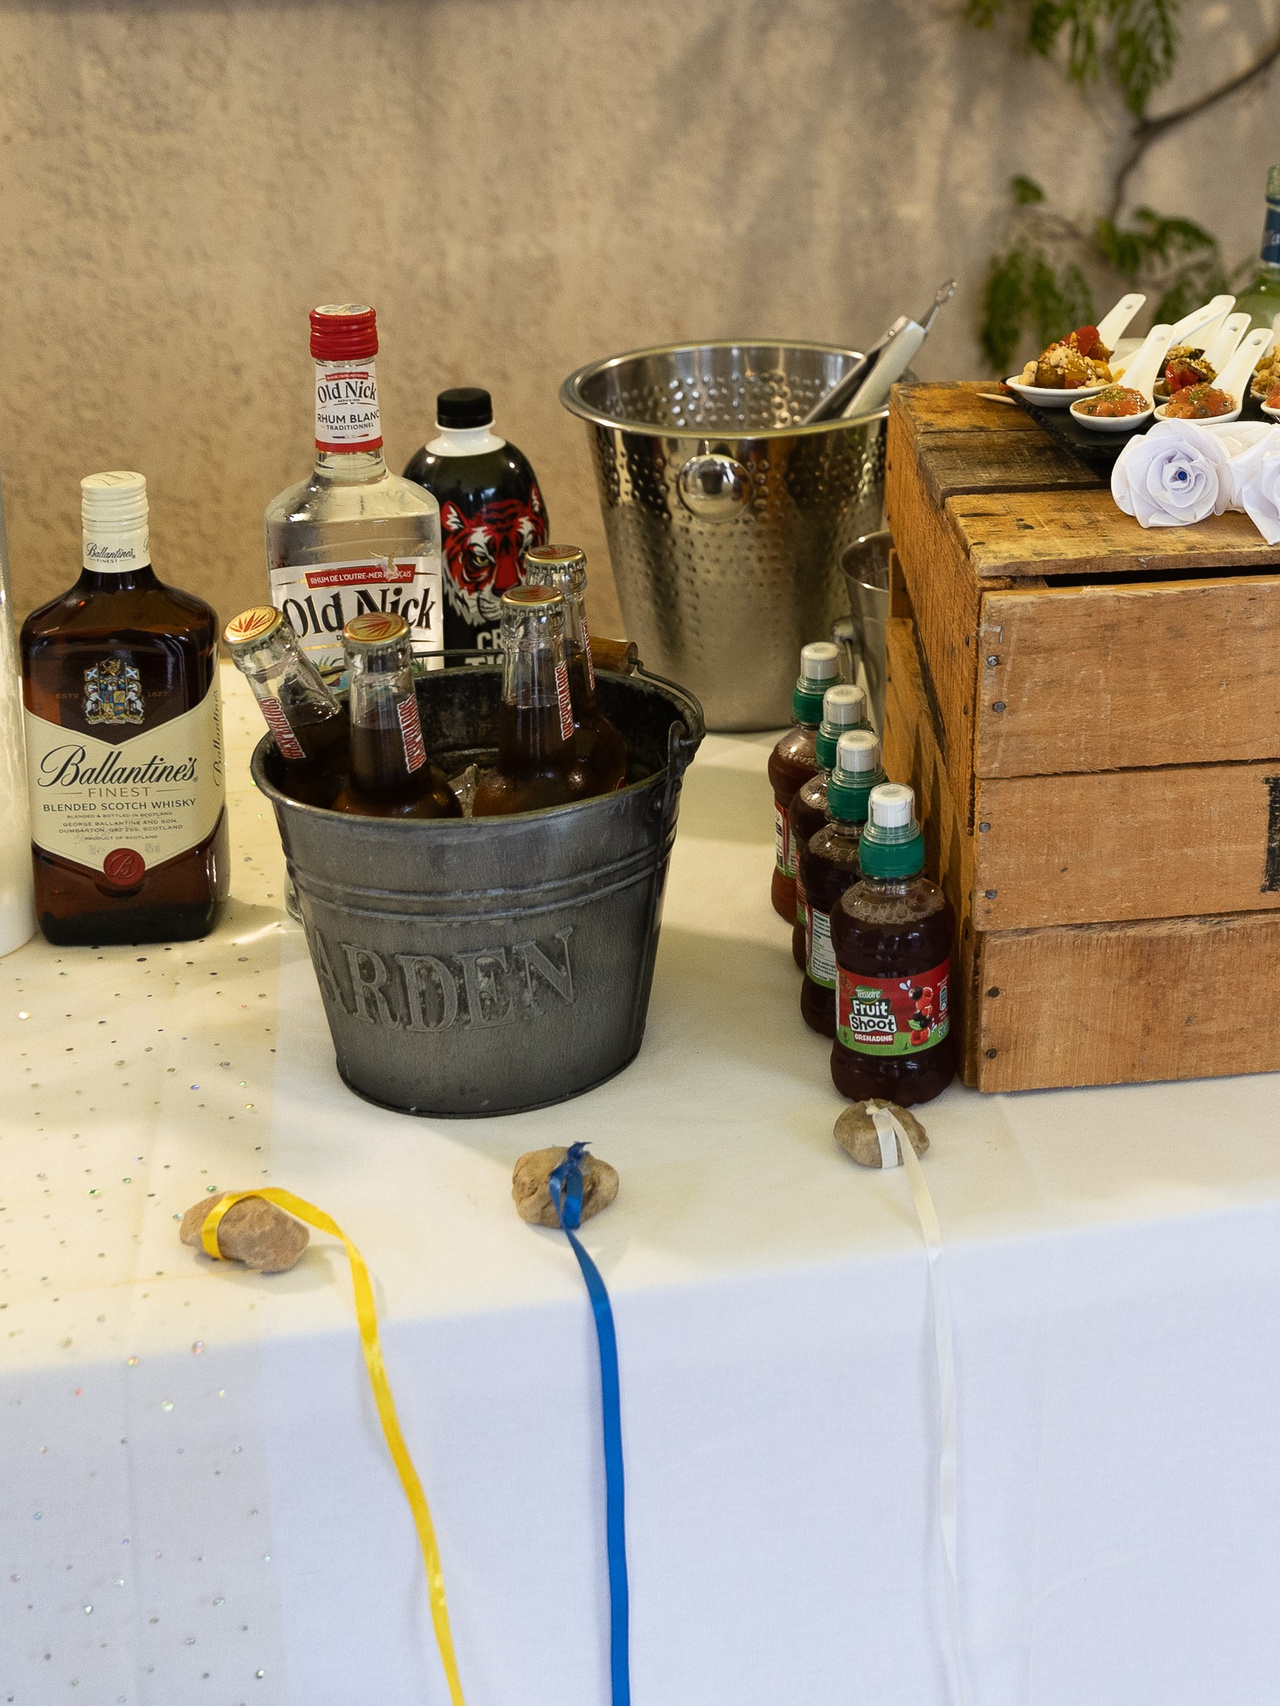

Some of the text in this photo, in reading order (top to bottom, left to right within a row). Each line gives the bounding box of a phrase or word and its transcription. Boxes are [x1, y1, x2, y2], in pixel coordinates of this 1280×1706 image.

[317, 381, 377, 404] Old Nick
[317, 409, 380, 424] RHUM BLANC
[326, 422, 374, 431] TRADITIONNEL
[310, 575, 330, 585] RHUM
[330, 574, 339, 582] DE
[282, 586, 436, 639] Old Nick
[37, 744, 198, 788] Ballantine's
[88, 787, 151, 798] FINEST
[43, 798, 196, 812] BLENDED SCOTCH WHISKY
[142, 824, 183, 832] SCOTLAND
[852, 1000, 888, 1016] Fruit
[850, 1016, 895, 1032] Shoot
[854, 1033, 893, 1042] GRENADINE
